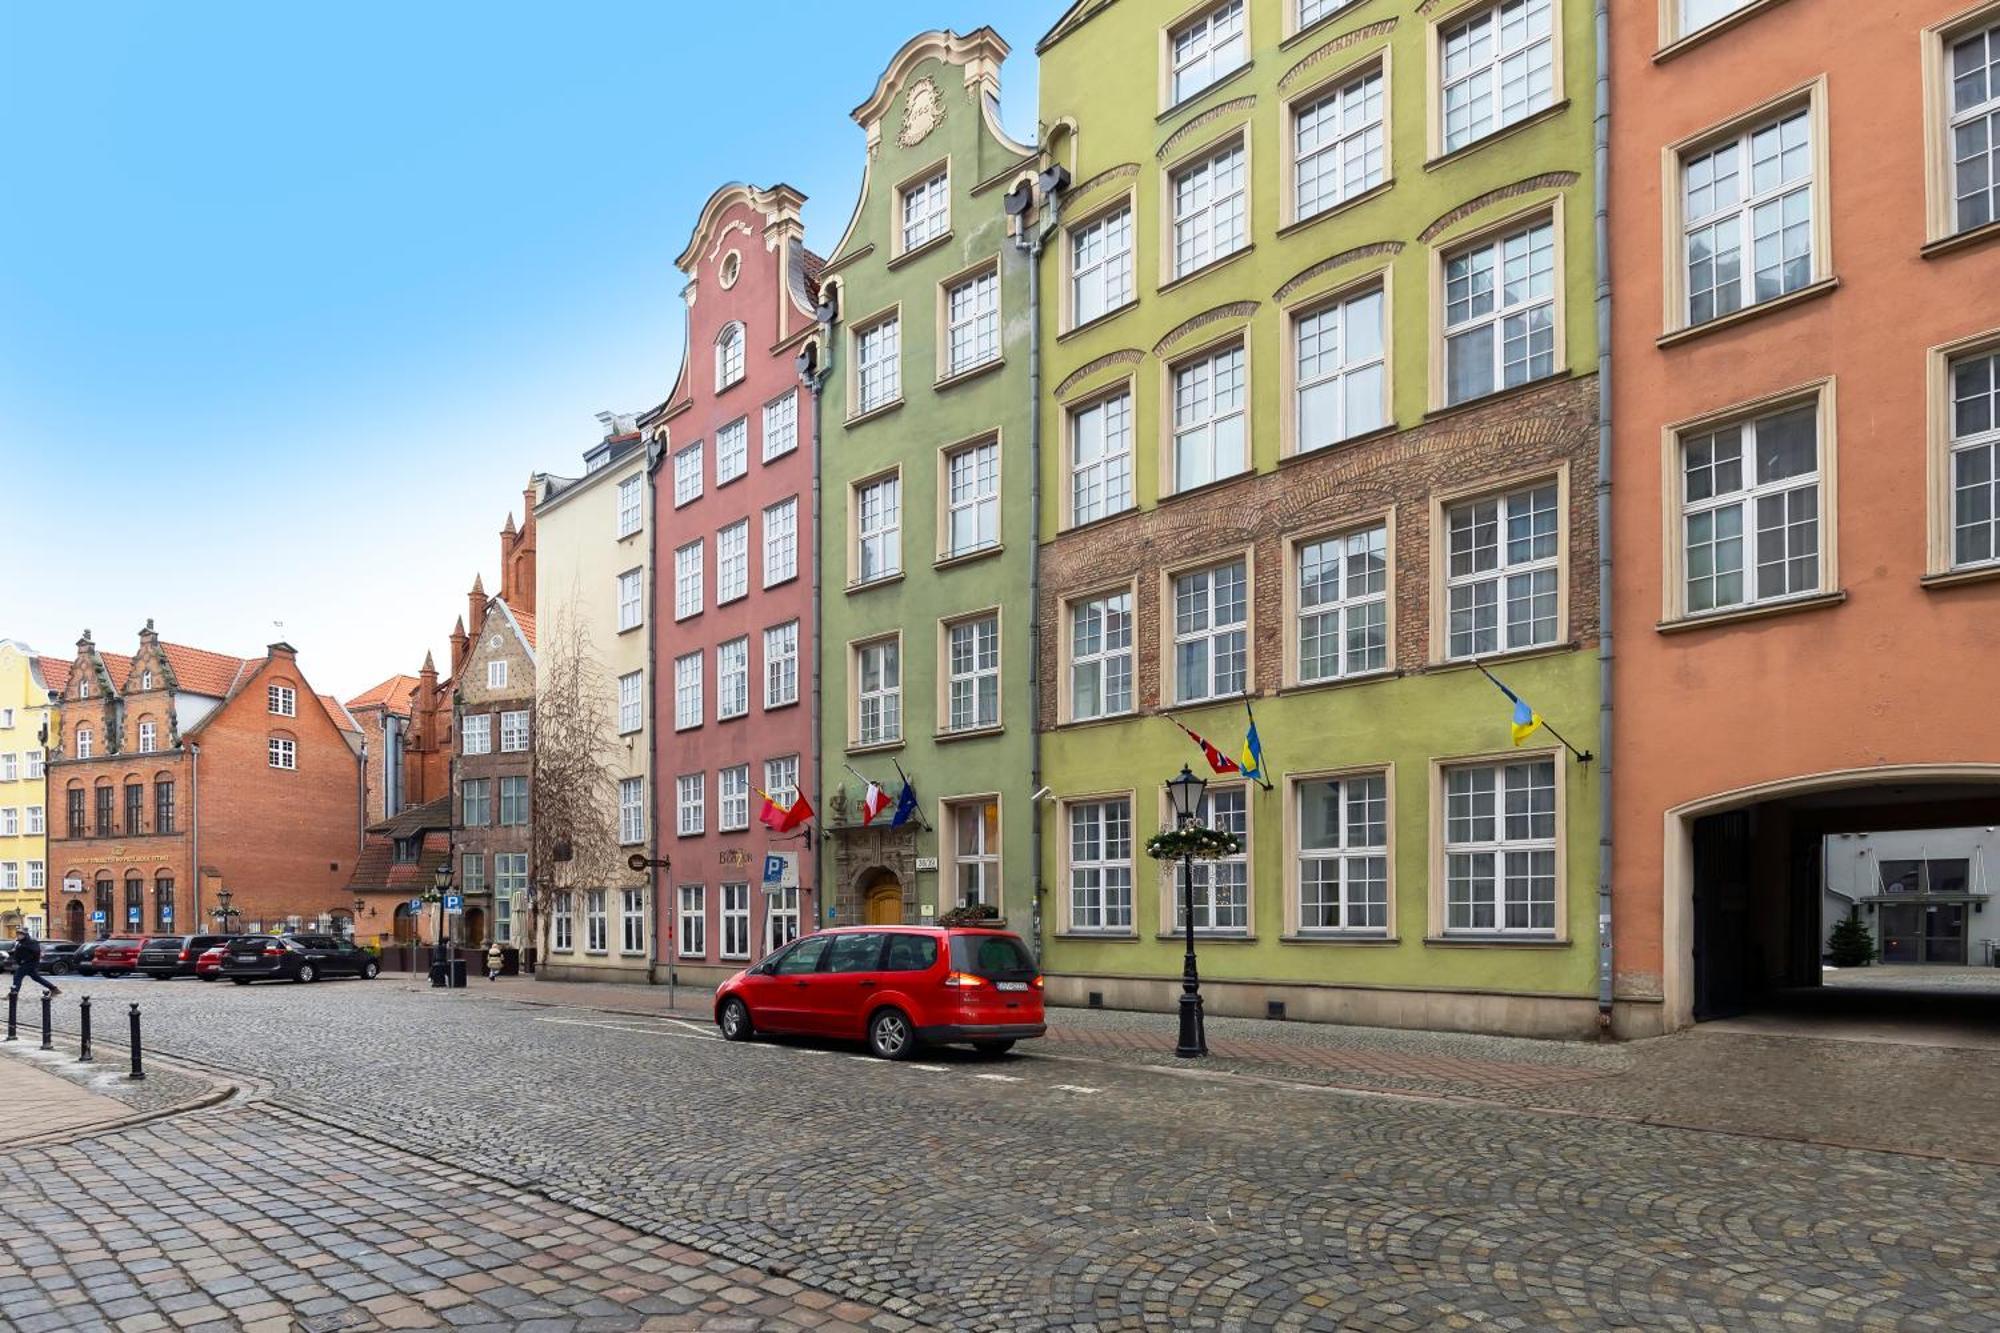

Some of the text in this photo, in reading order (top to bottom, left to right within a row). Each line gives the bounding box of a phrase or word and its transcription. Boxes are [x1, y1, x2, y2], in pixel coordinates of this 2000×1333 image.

[768, 859, 779, 875] P
[412, 900, 420, 908] P
[448, 896, 458, 907] P
